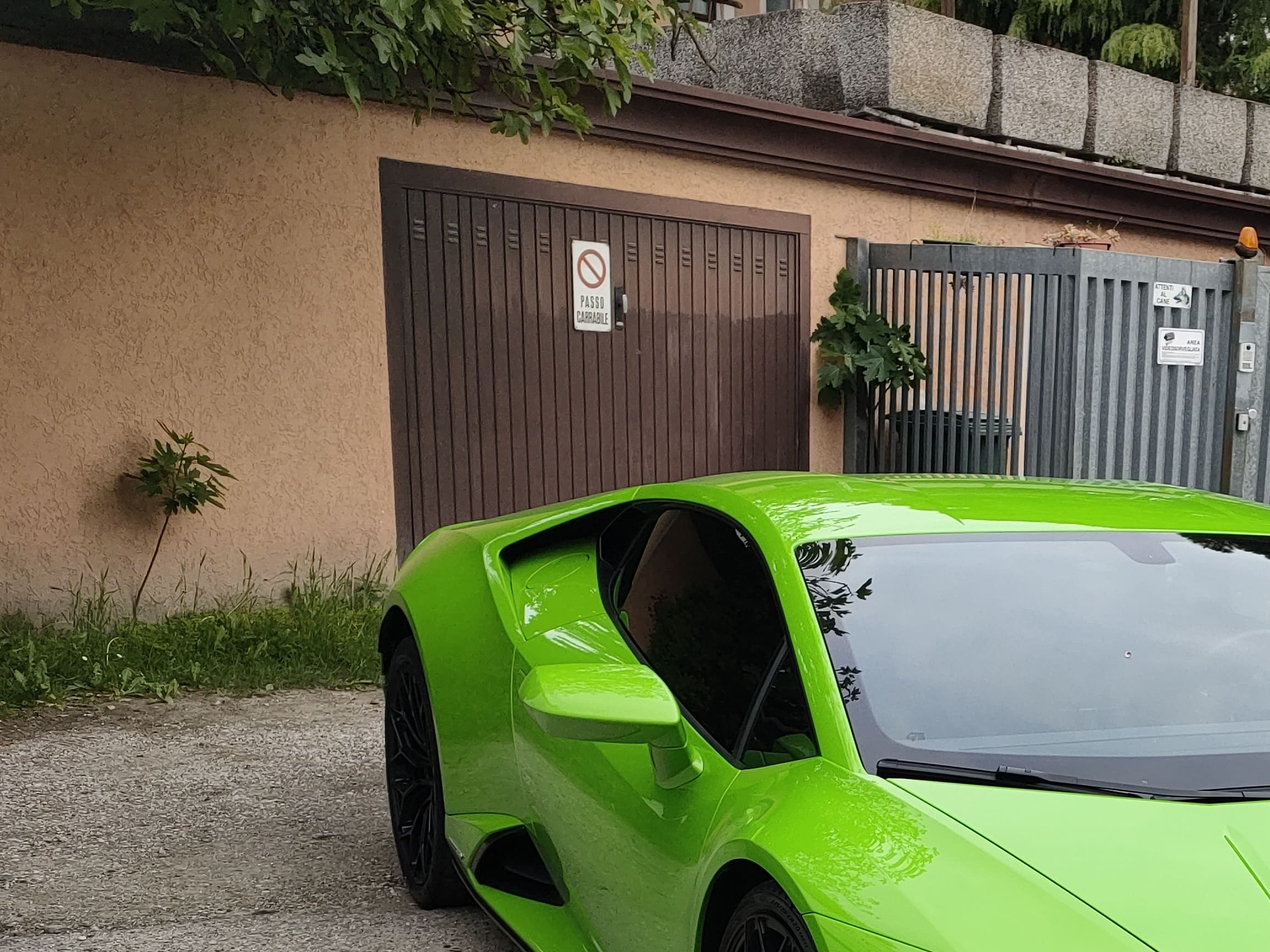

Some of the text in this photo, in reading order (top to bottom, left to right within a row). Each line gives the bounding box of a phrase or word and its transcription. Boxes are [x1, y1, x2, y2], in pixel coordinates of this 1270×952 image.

[1155, 283, 1174, 291] ATTENTI
[580, 295, 605, 309] PASSO
[1156, 297, 1170, 305] CANE
[577, 310, 609, 325] CARRABILE
